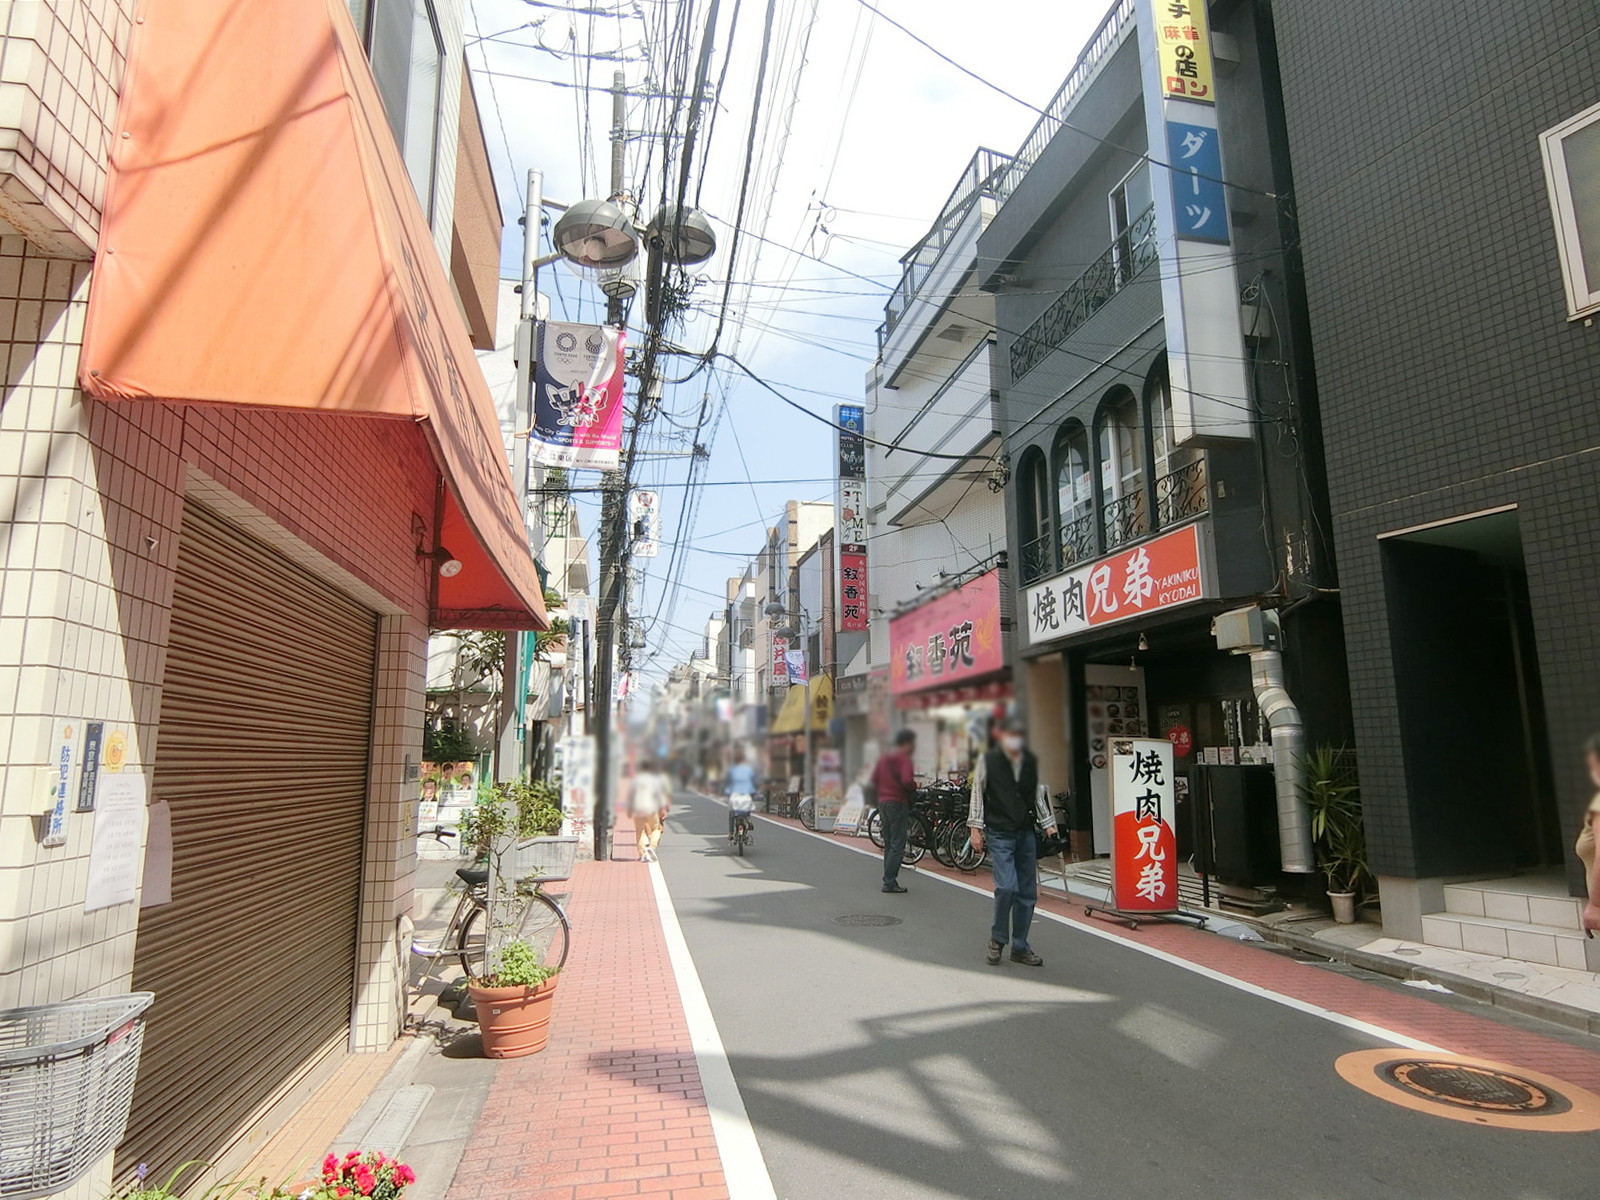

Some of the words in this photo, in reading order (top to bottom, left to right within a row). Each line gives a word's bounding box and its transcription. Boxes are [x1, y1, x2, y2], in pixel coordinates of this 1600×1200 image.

[1163, 25, 1200, 41] 麻雀
[1175, 45, 1199, 78] の店
[1167, 76, 1208, 97] ロン
[1180, 130, 1212, 231] ダーツ
[550, 453, 573, 462] 江東区
[852, 491, 864, 543] TIME
[1154, 567, 1199, 591] YAKINIKU
[843, 566, 859, 620] 叙香苑
[1159, 584, 1197, 606] KYODAI
[1169, 732, 1189, 744] 兄弟
[1129, 749, 1167, 903] 焼肉兄弟
